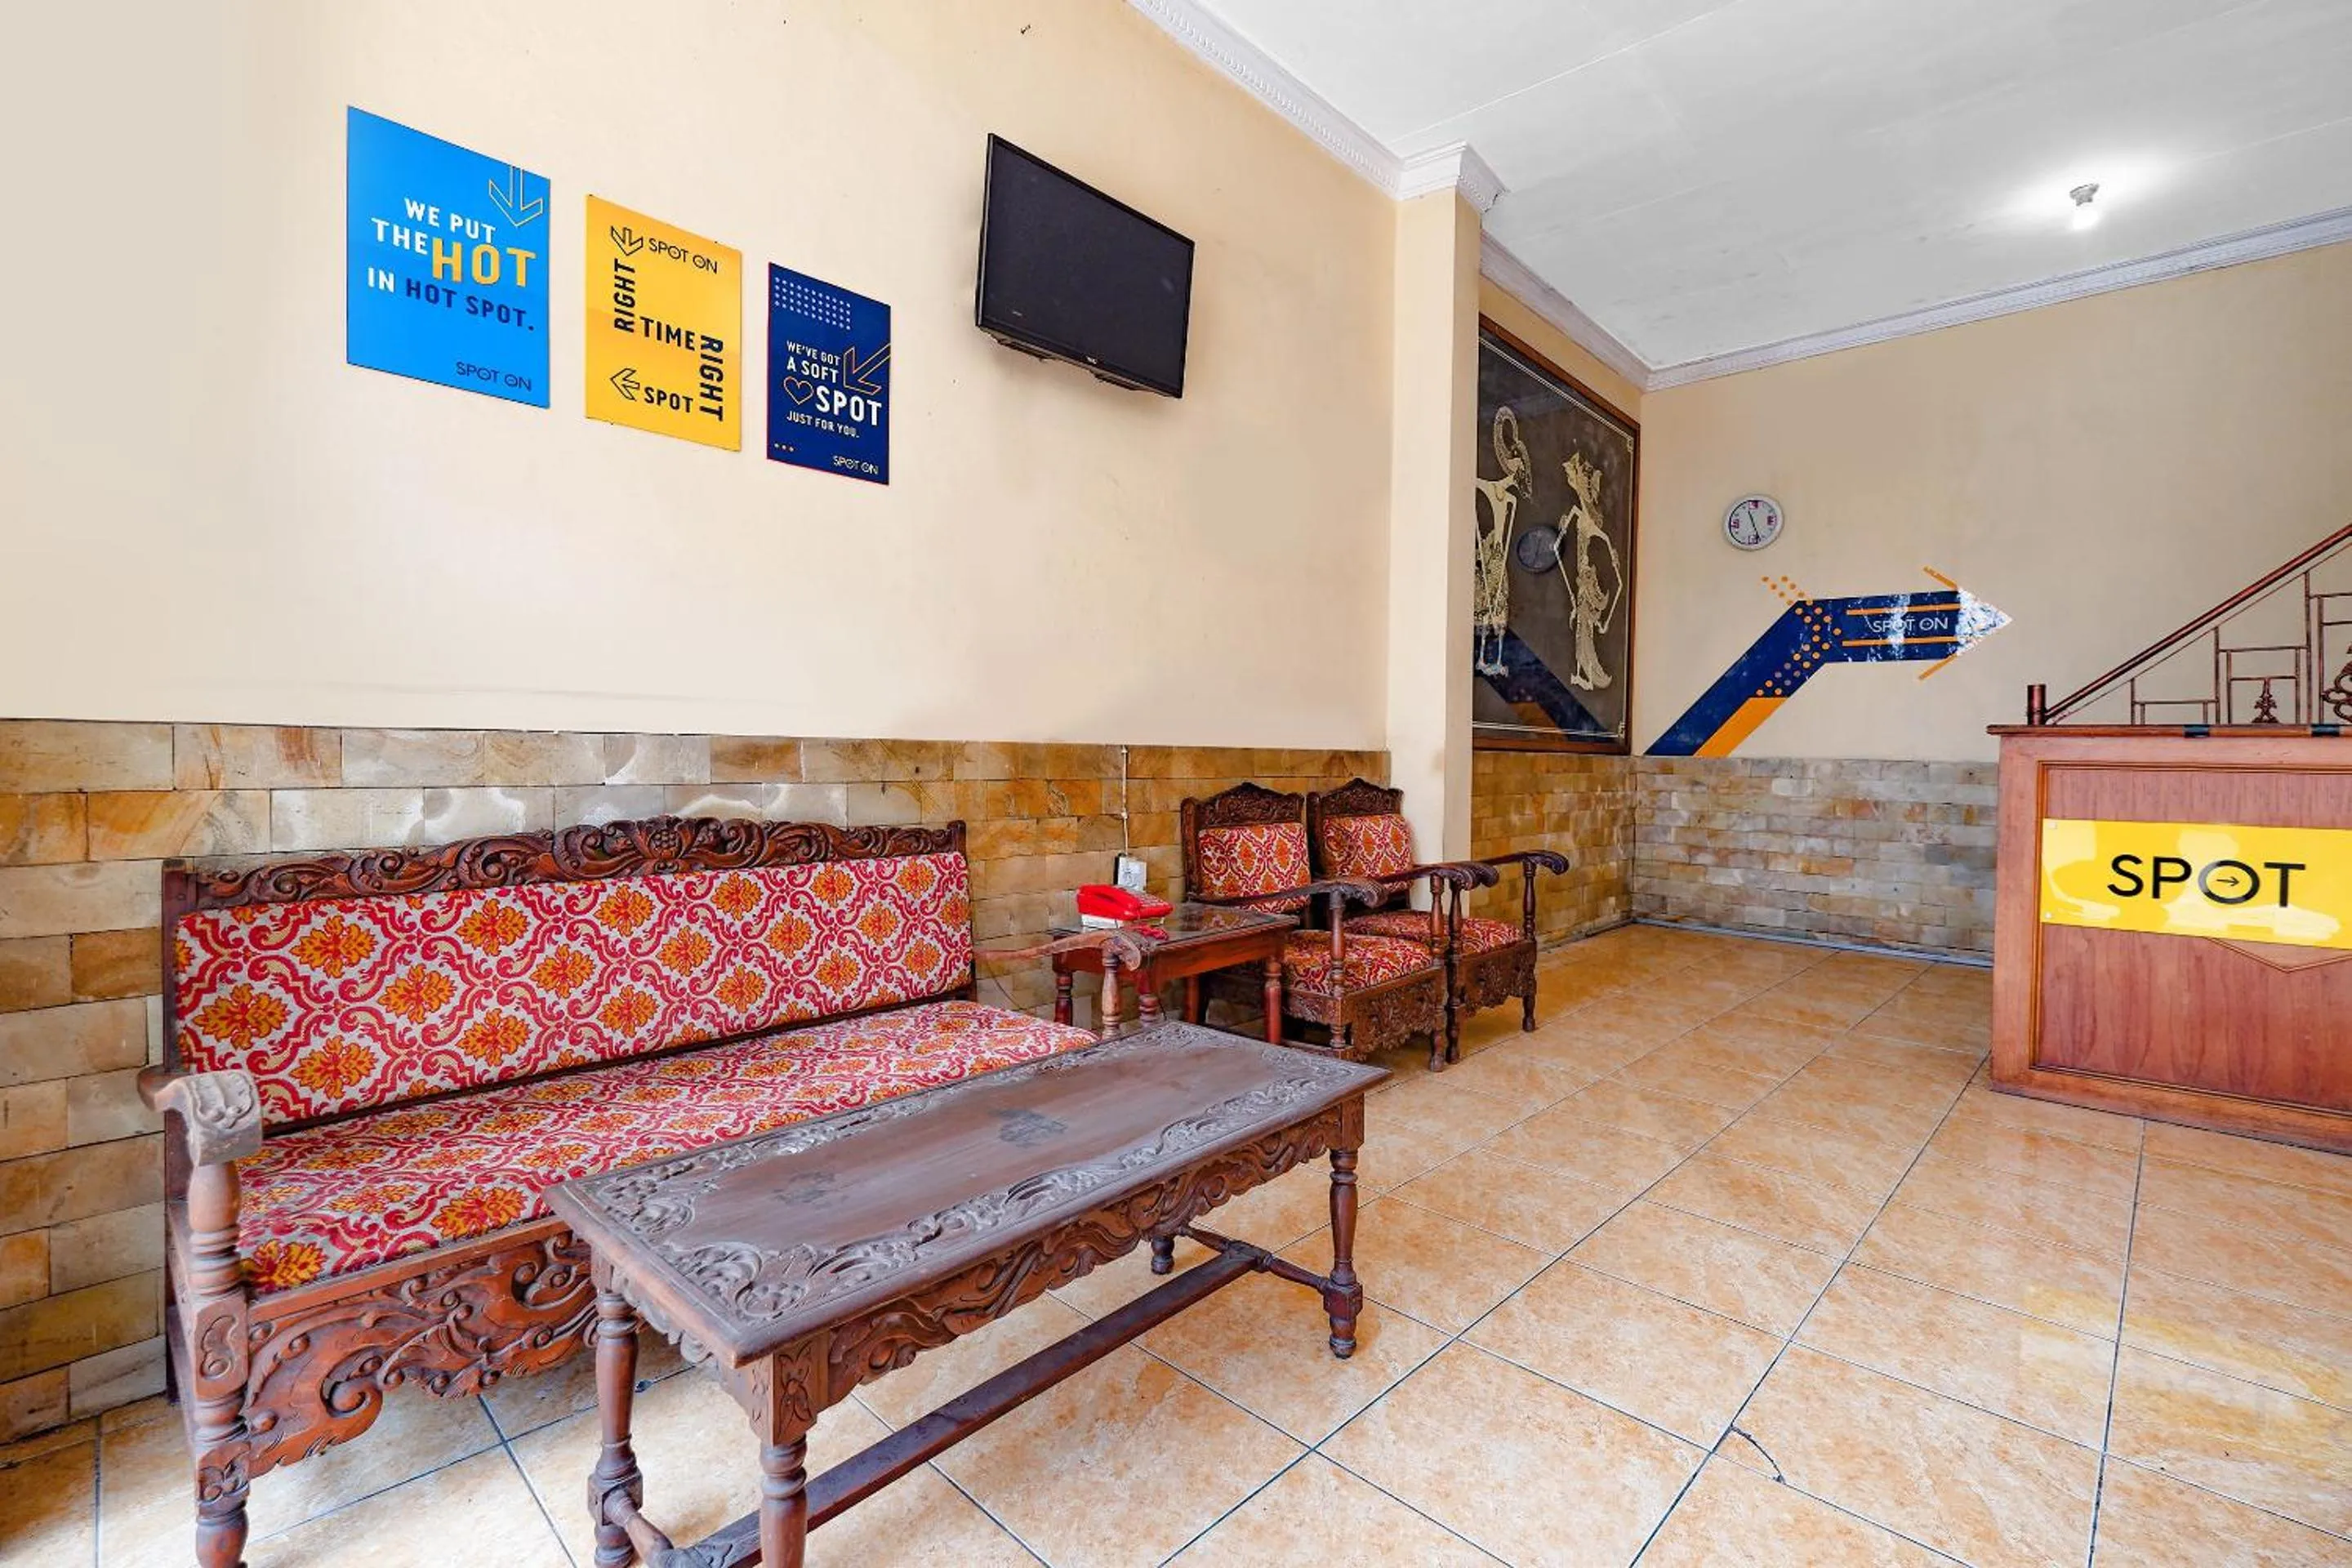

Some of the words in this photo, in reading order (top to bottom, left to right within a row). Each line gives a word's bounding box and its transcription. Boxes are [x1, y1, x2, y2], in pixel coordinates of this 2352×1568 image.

[404, 197, 440, 228] WE
[450, 212, 497, 243] PUT
[371, 216, 428, 255] THE
[432, 237, 537, 287] HOT
[648, 238, 688, 262] SPOT
[693, 254, 718, 274] ON
[368, 267, 394, 293] IN
[406, 278, 457, 309] HOT
[466, 295, 534, 331] SPOT.
[613, 258, 635, 333] RIGHT
[640, 316, 695, 351] TIME
[786, 340, 817, 360] WE'VE
[821, 351, 841, 366] GOT
[786, 355, 797, 372] A
[801, 359, 839, 384] SOFT
[456, 362, 499, 384] SPOT
[505, 373, 532, 391] ON
[699, 335, 724, 421] RIGHT
[644, 386, 693, 412] SPOT
[816, 385, 882, 426] SPOT
[786, 411, 813, 426] JUST
[815, 417, 835, 432] FOR
[833, 455, 859, 470] SPOT
[861, 462, 879, 474] ON
[1873, 619, 1916, 633] SPOT
[1919, 617, 1949, 630] ON
[2107, 853, 2306, 908] SPOT
